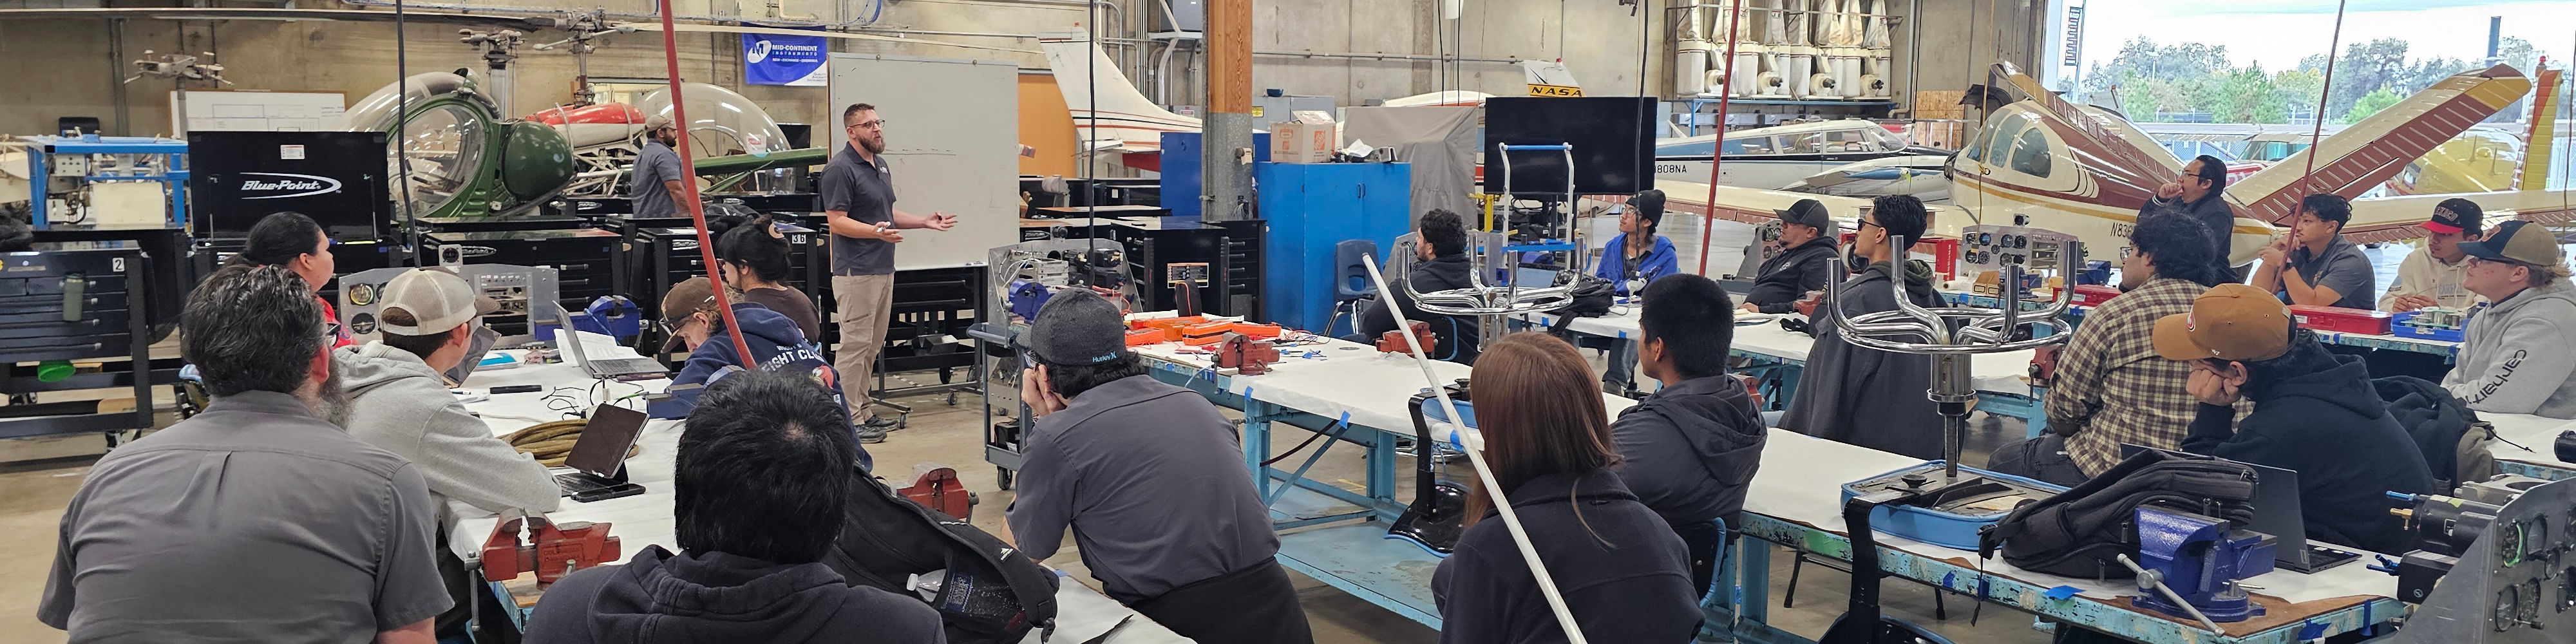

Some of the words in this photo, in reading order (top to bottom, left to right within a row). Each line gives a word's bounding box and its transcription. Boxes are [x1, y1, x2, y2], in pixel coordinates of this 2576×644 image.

[1531, 86, 1582, 97] NASA
[1655, 164, 1687, 173] 808NA
[241, 180, 320, 191] Blue-Point
[2434, 206, 2459, 222] EXICO
[793, 234, 806, 243] 36
[115, 259, 122, 270] 2
